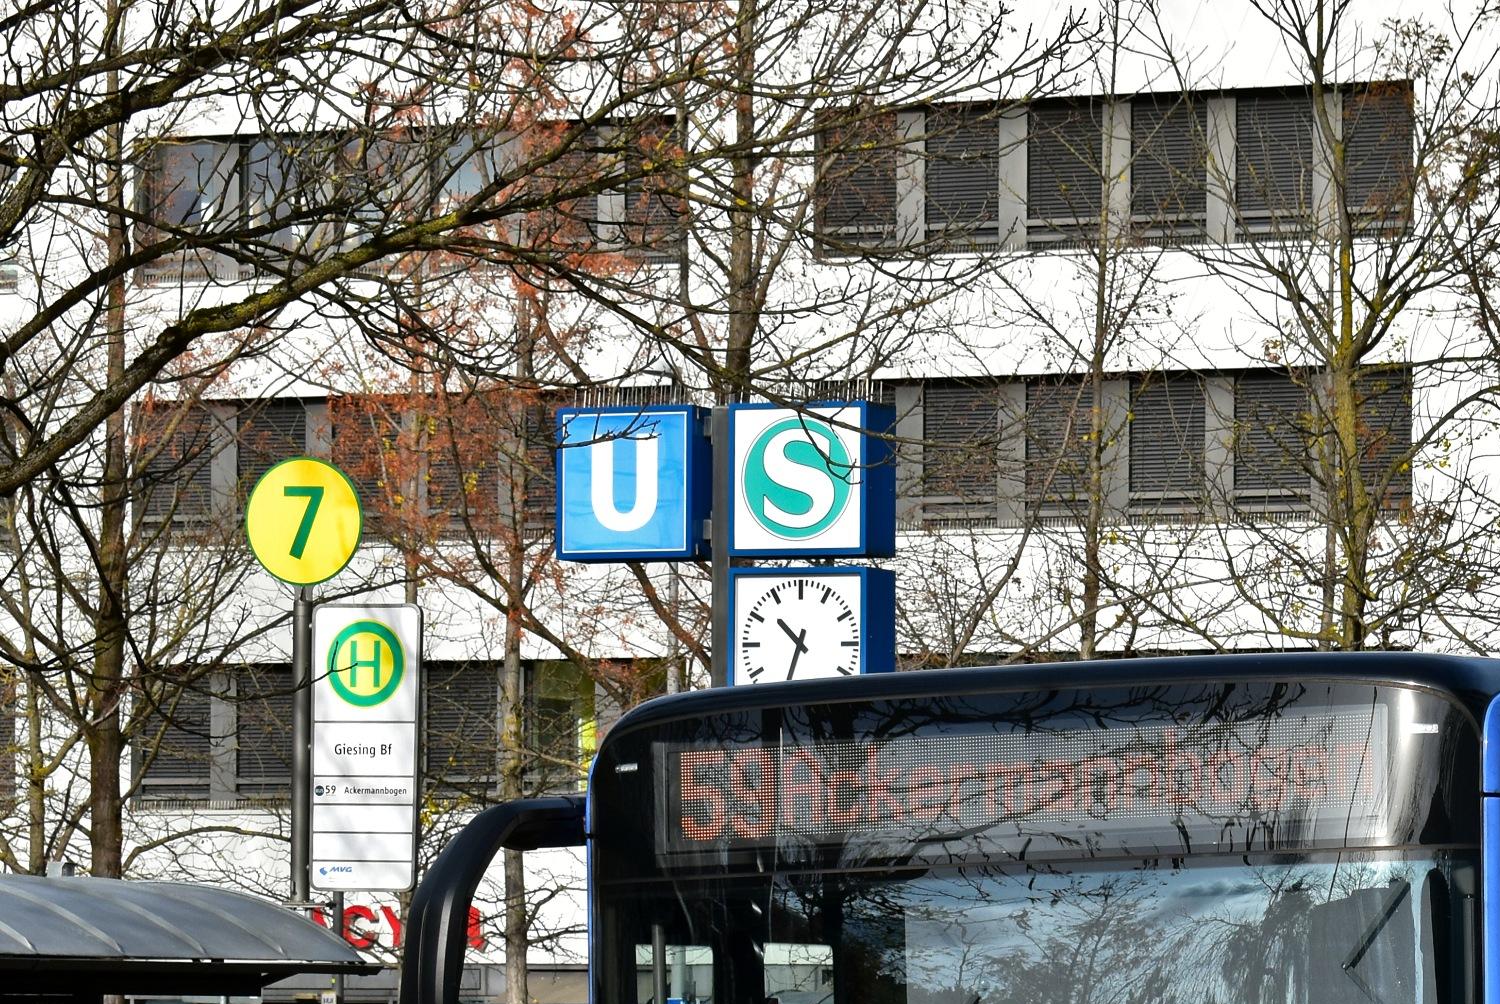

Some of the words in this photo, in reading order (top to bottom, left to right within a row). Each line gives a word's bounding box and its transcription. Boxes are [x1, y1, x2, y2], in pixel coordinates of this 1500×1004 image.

[591, 433, 658, 532] U
[763, 427, 835, 529] S
[283, 486, 325, 560] 7
[350, 640, 381, 688] H
[334, 743, 376, 758] Giesing
[380, 743, 392, 755] Bf
[681, 748, 777, 840] 59
[782, 728, 1374, 825] Ackermannbogen
[325, 785, 336, 794] 59
[344, 786, 407, 796] Ackermannbogen
